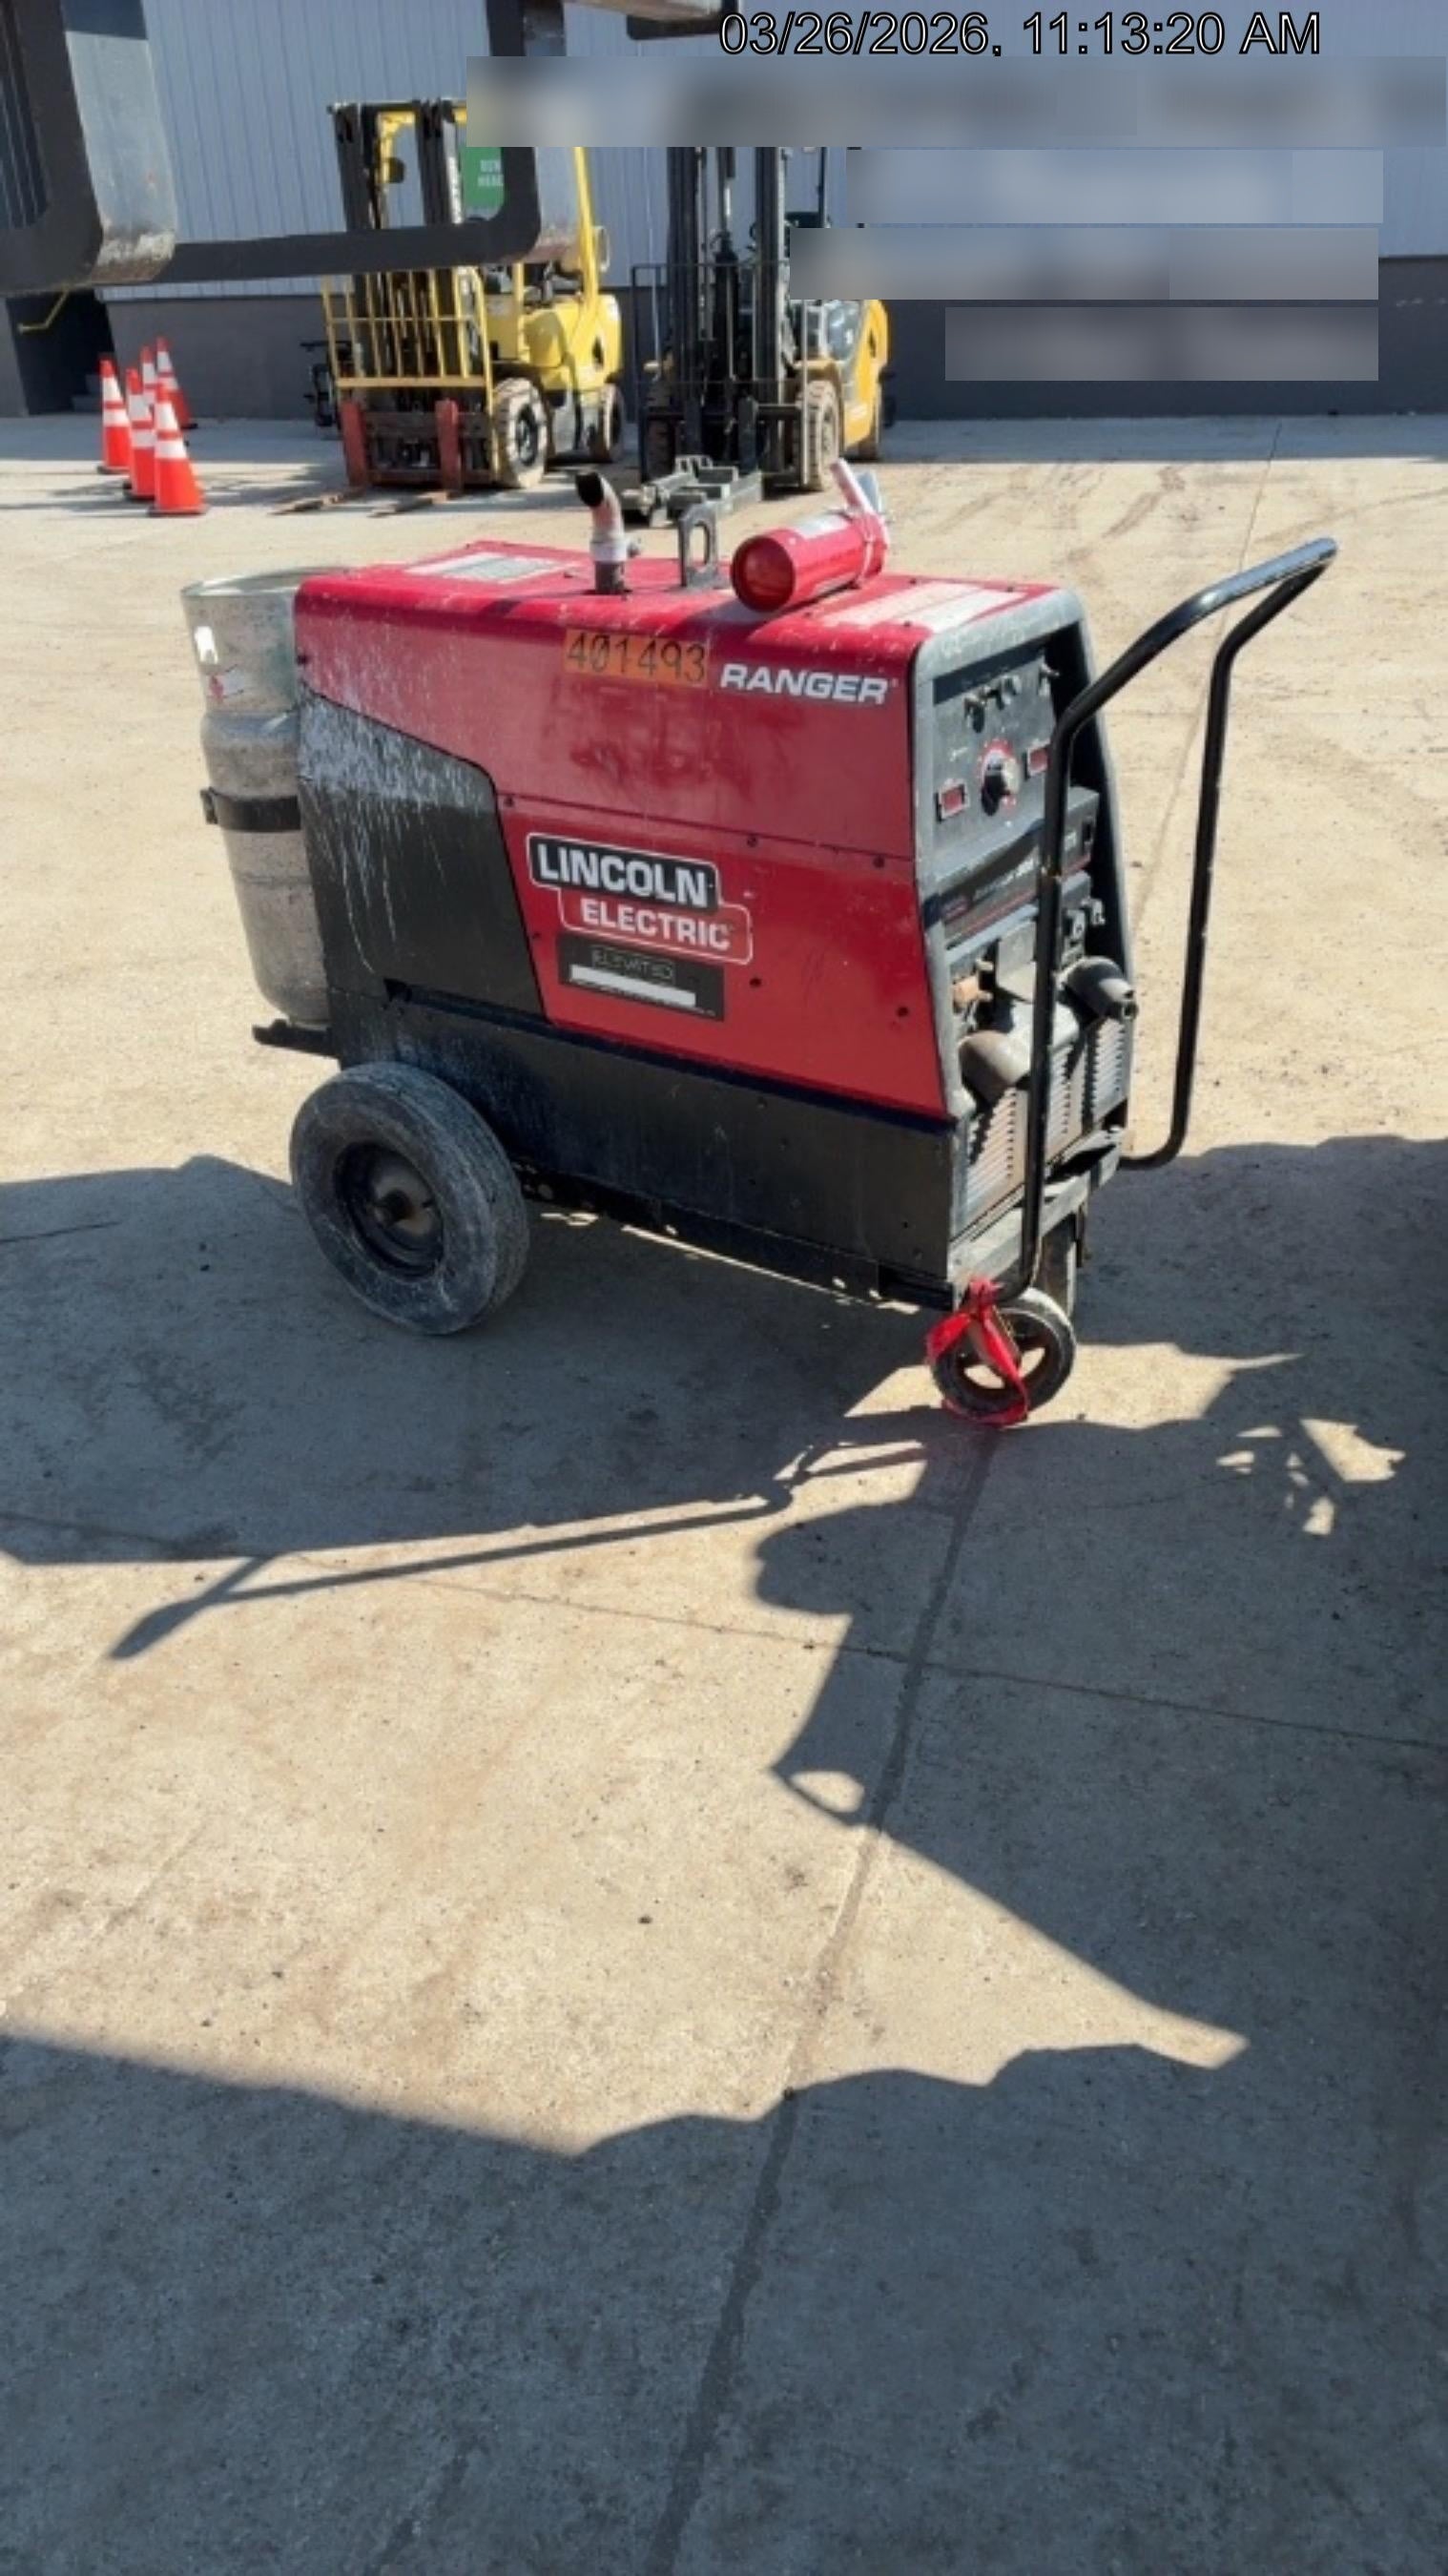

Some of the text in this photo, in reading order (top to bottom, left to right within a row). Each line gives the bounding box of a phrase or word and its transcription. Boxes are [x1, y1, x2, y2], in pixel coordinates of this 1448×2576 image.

[568, 632, 706, 683] 401493
[537, 843, 708, 907] LINCOLN
[580, 898, 732, 950] ELECTRIC
